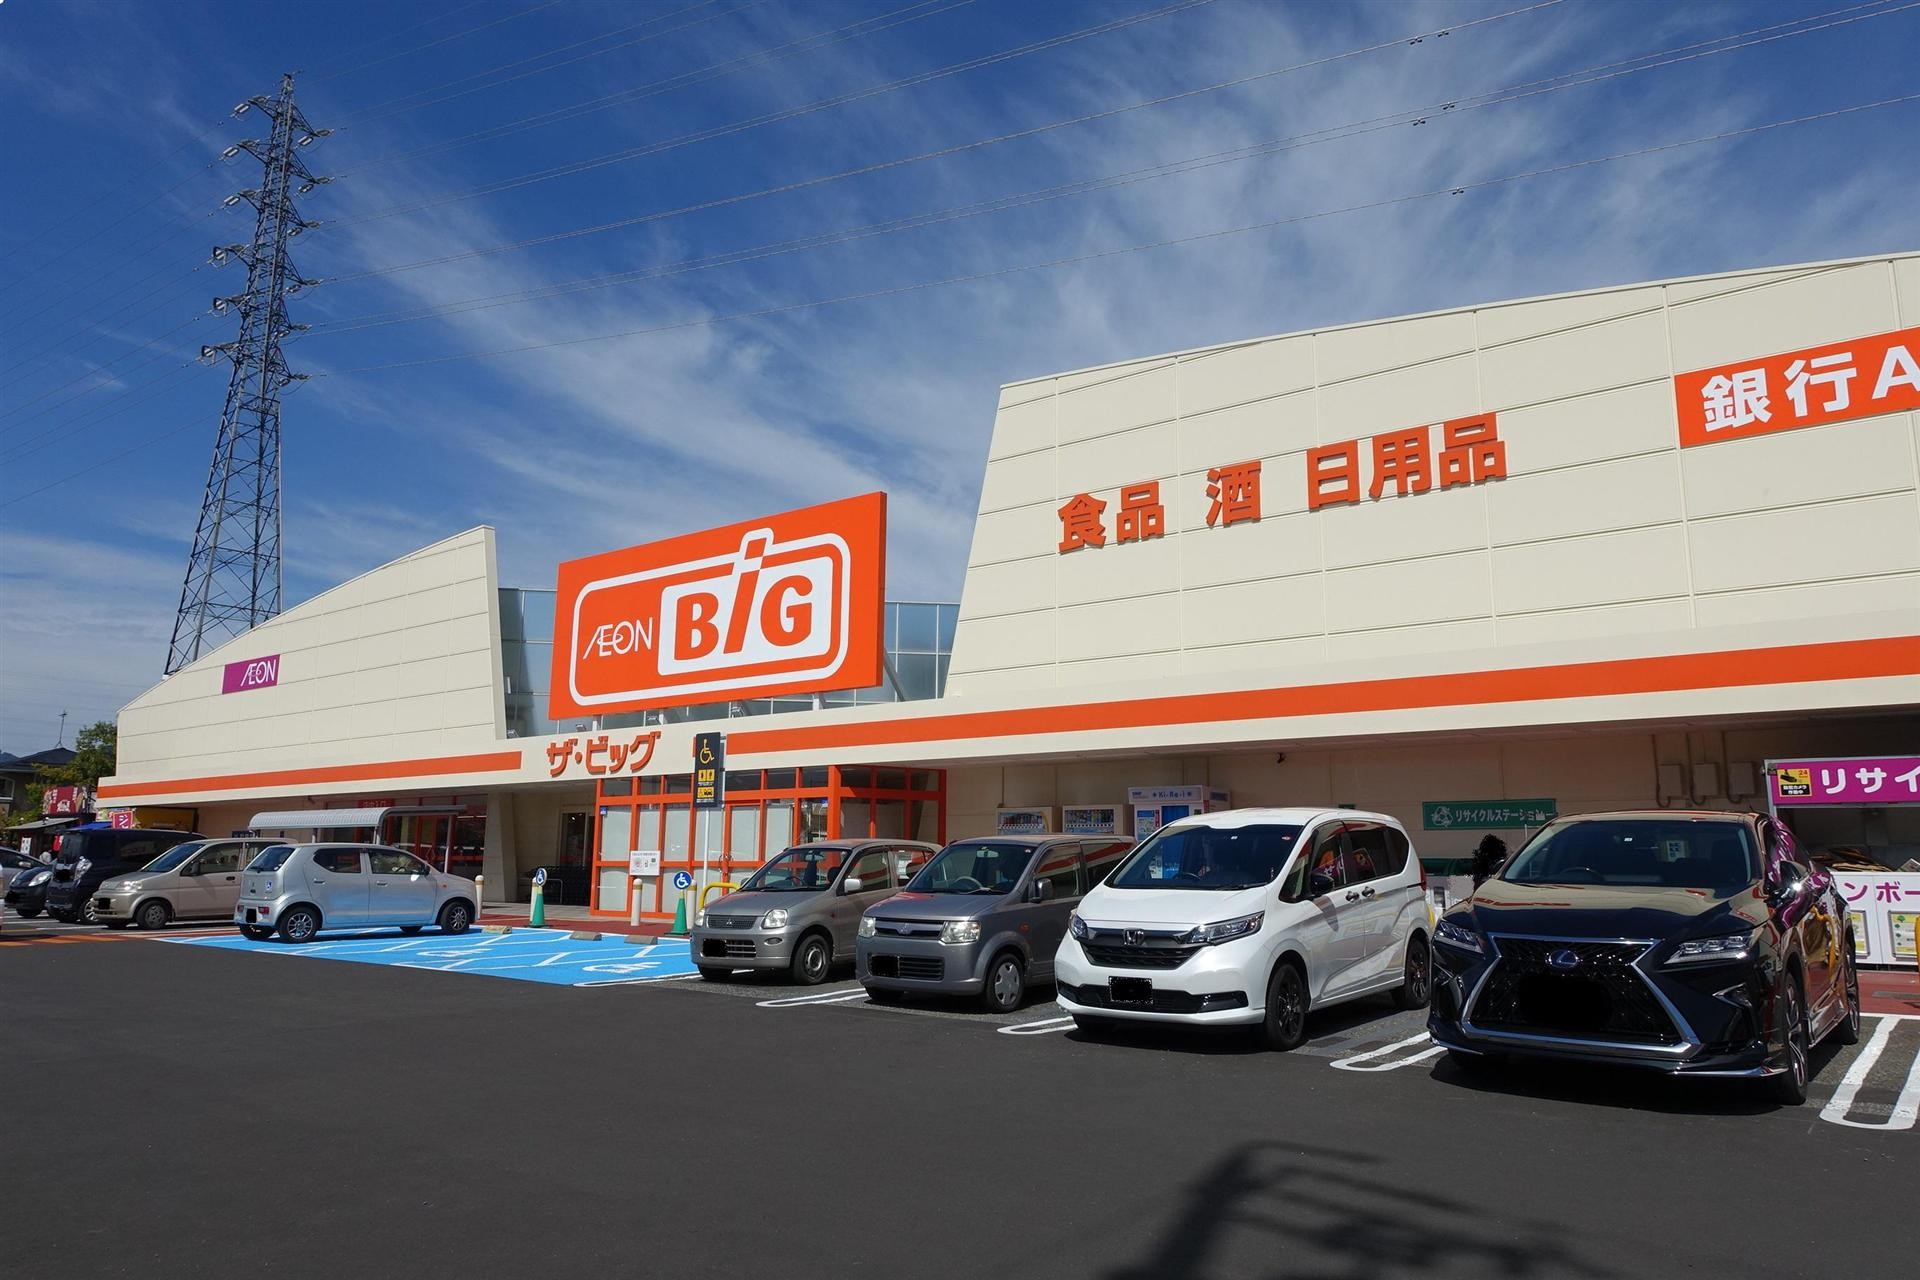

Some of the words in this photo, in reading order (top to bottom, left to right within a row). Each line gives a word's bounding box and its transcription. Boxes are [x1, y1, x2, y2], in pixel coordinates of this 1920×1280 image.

[1058, 481, 1164, 554] 食品
[1206, 460, 1262, 528] 酒
[1306, 412, 1507, 512] 日用品
